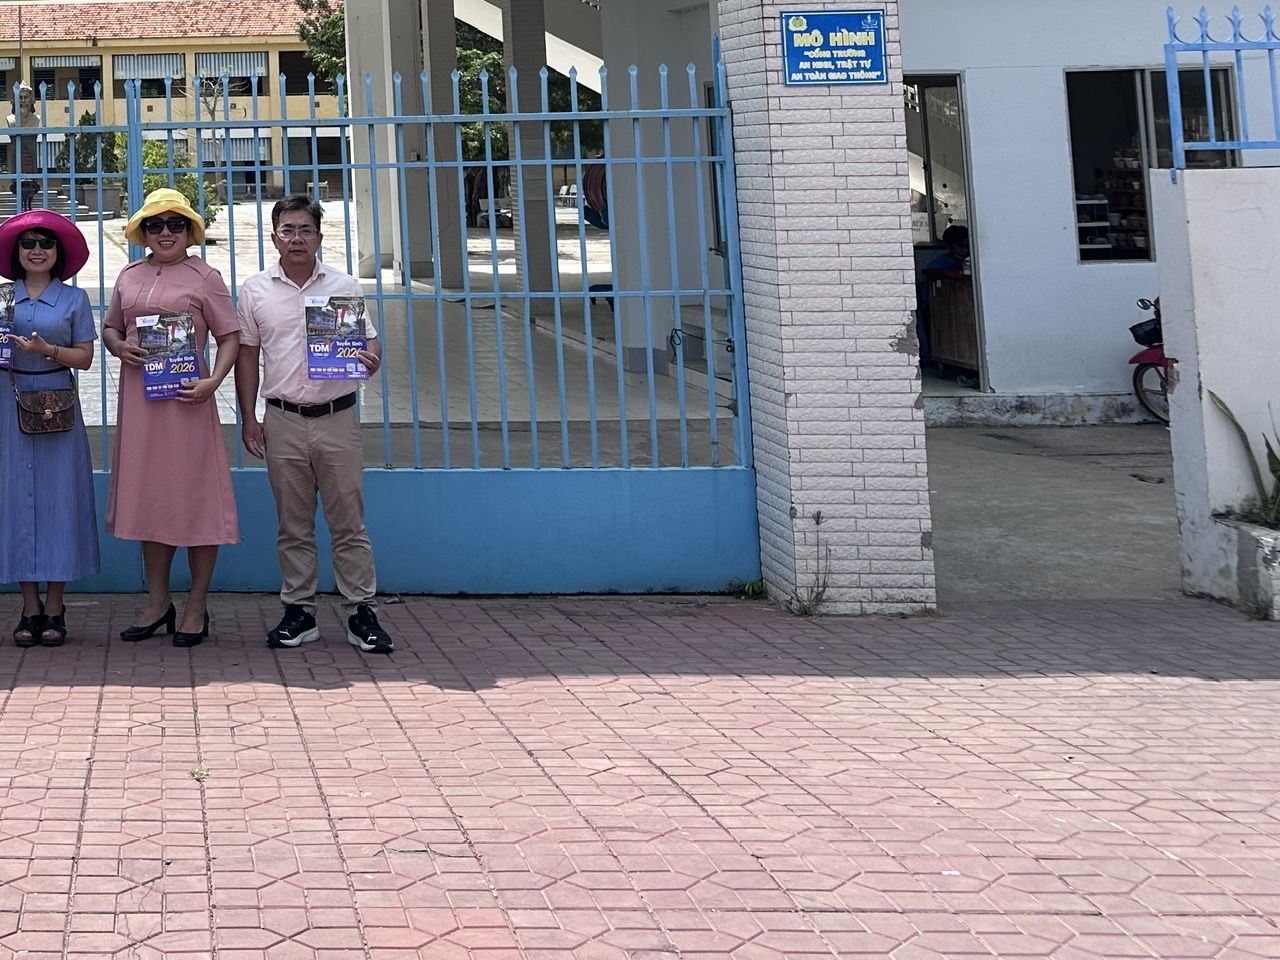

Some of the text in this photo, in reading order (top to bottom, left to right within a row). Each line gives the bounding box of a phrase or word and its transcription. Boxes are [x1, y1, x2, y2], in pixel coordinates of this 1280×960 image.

[793, 28, 875, 47] MÔ HÌNH
[309, 344, 330, 352] TDM
[144, 362, 163, 372] TDM
[170, 362, 195, 374] 2026
